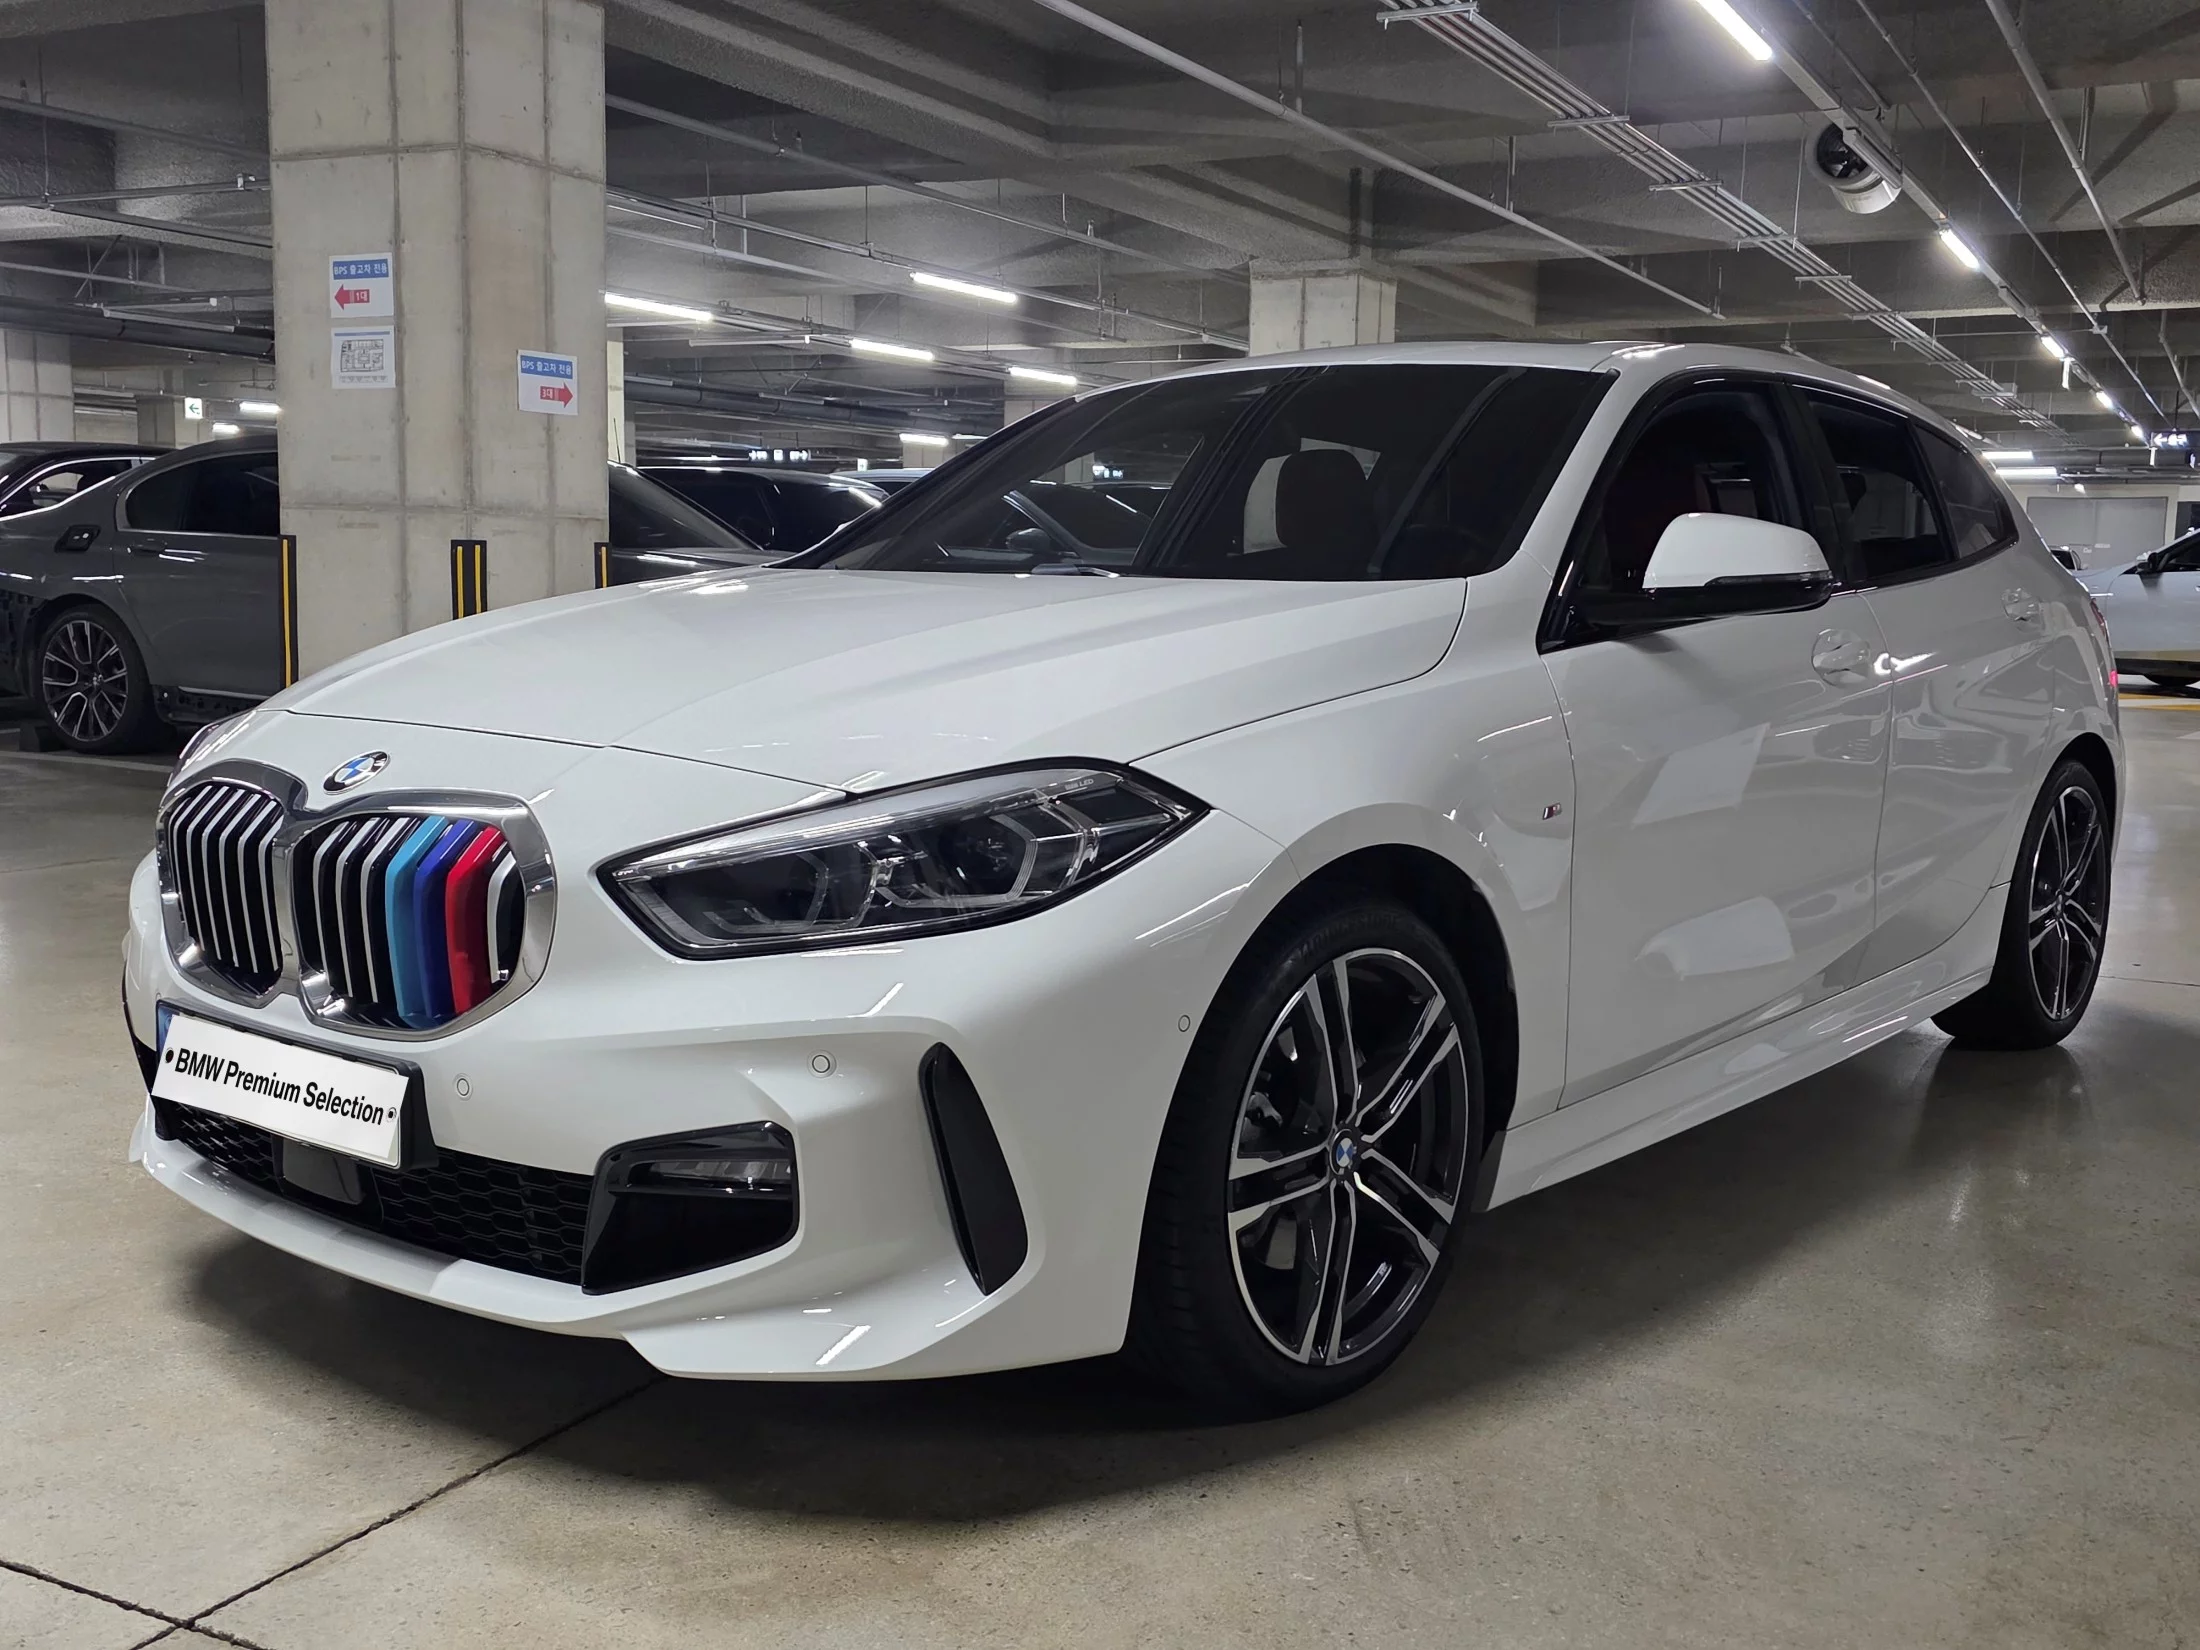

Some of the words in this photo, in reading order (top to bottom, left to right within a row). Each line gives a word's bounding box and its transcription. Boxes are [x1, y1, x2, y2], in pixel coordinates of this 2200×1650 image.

[334, 265, 348, 275] BPS
[350, 264, 371, 275] 출고차
[373, 262, 387, 274] 전용
[356, 291, 368, 302] 1대
[521, 360, 535, 370] BPS
[175, 1048, 225, 1082] BMW
[224, 1060, 301, 1103] Premium
[303, 1081, 384, 1126] Selection
